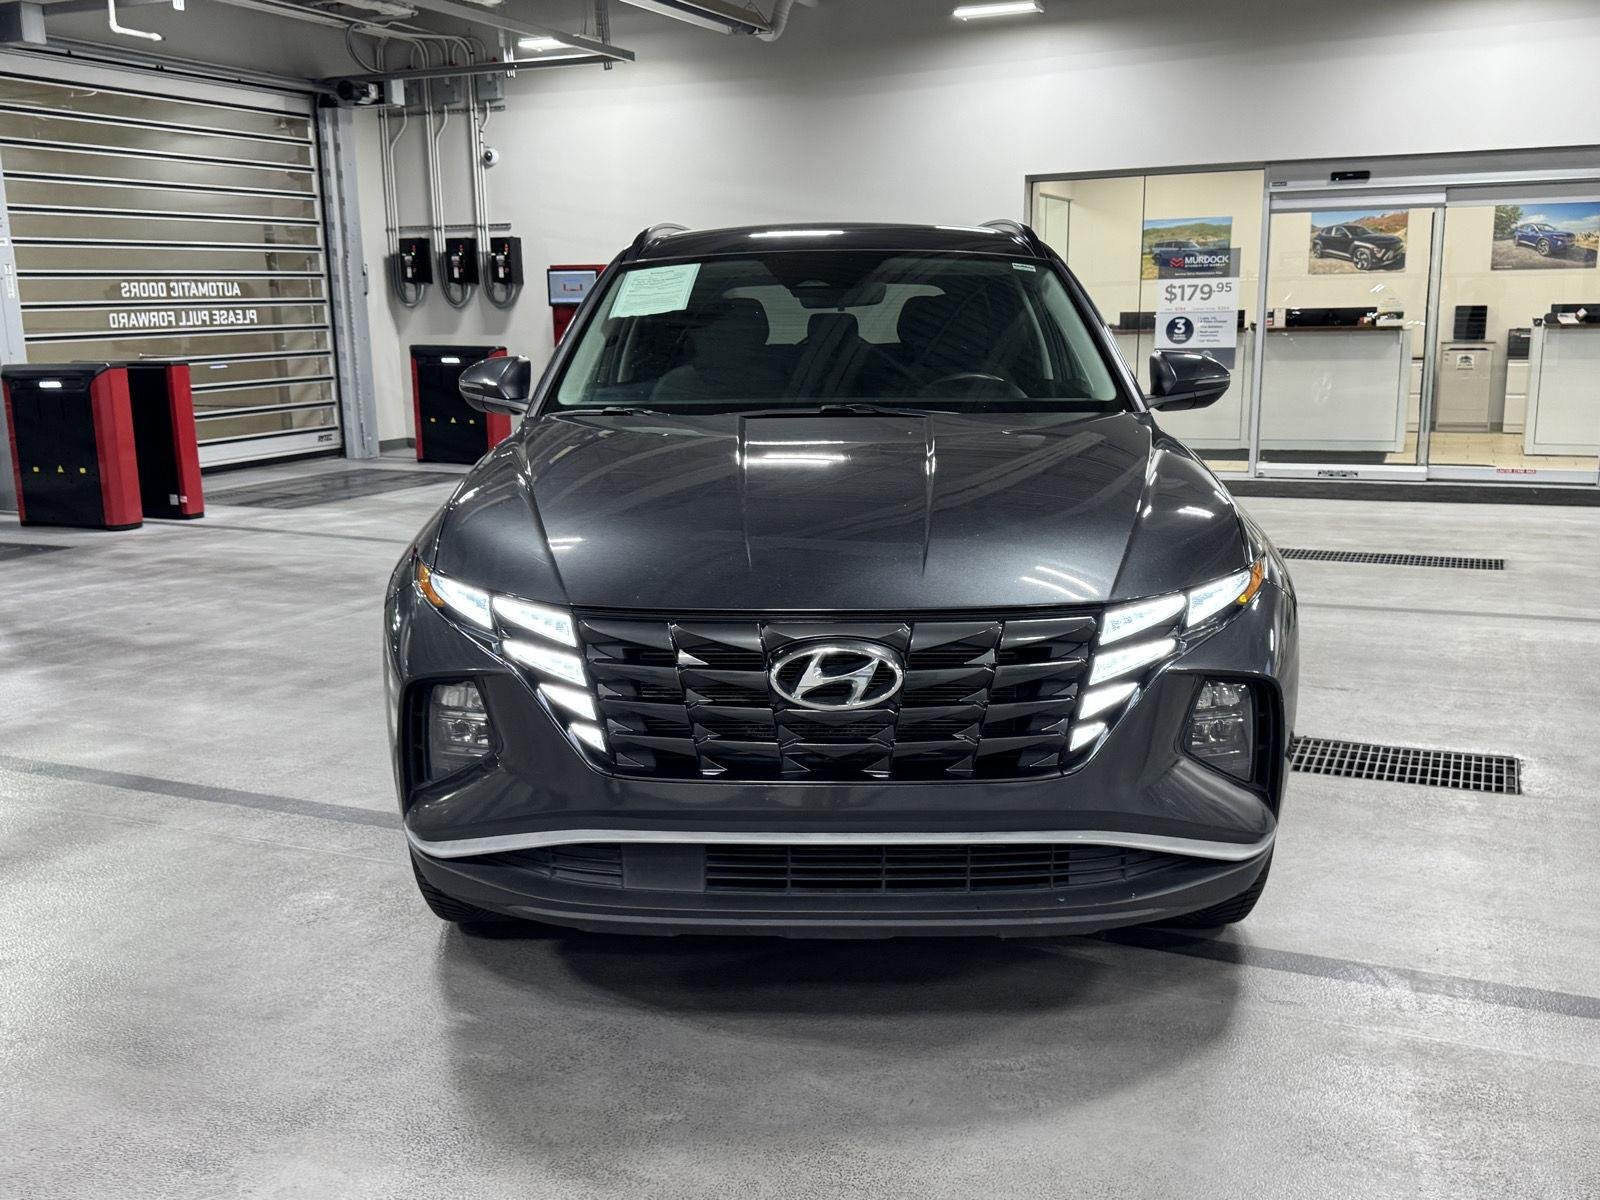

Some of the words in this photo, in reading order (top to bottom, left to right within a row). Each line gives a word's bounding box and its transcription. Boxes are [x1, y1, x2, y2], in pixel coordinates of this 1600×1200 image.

[1184, 255, 1229, 264] MURDOCK
[1165, 282, 1232, 303] $179.95
[1174, 318, 1186, 334] 3
